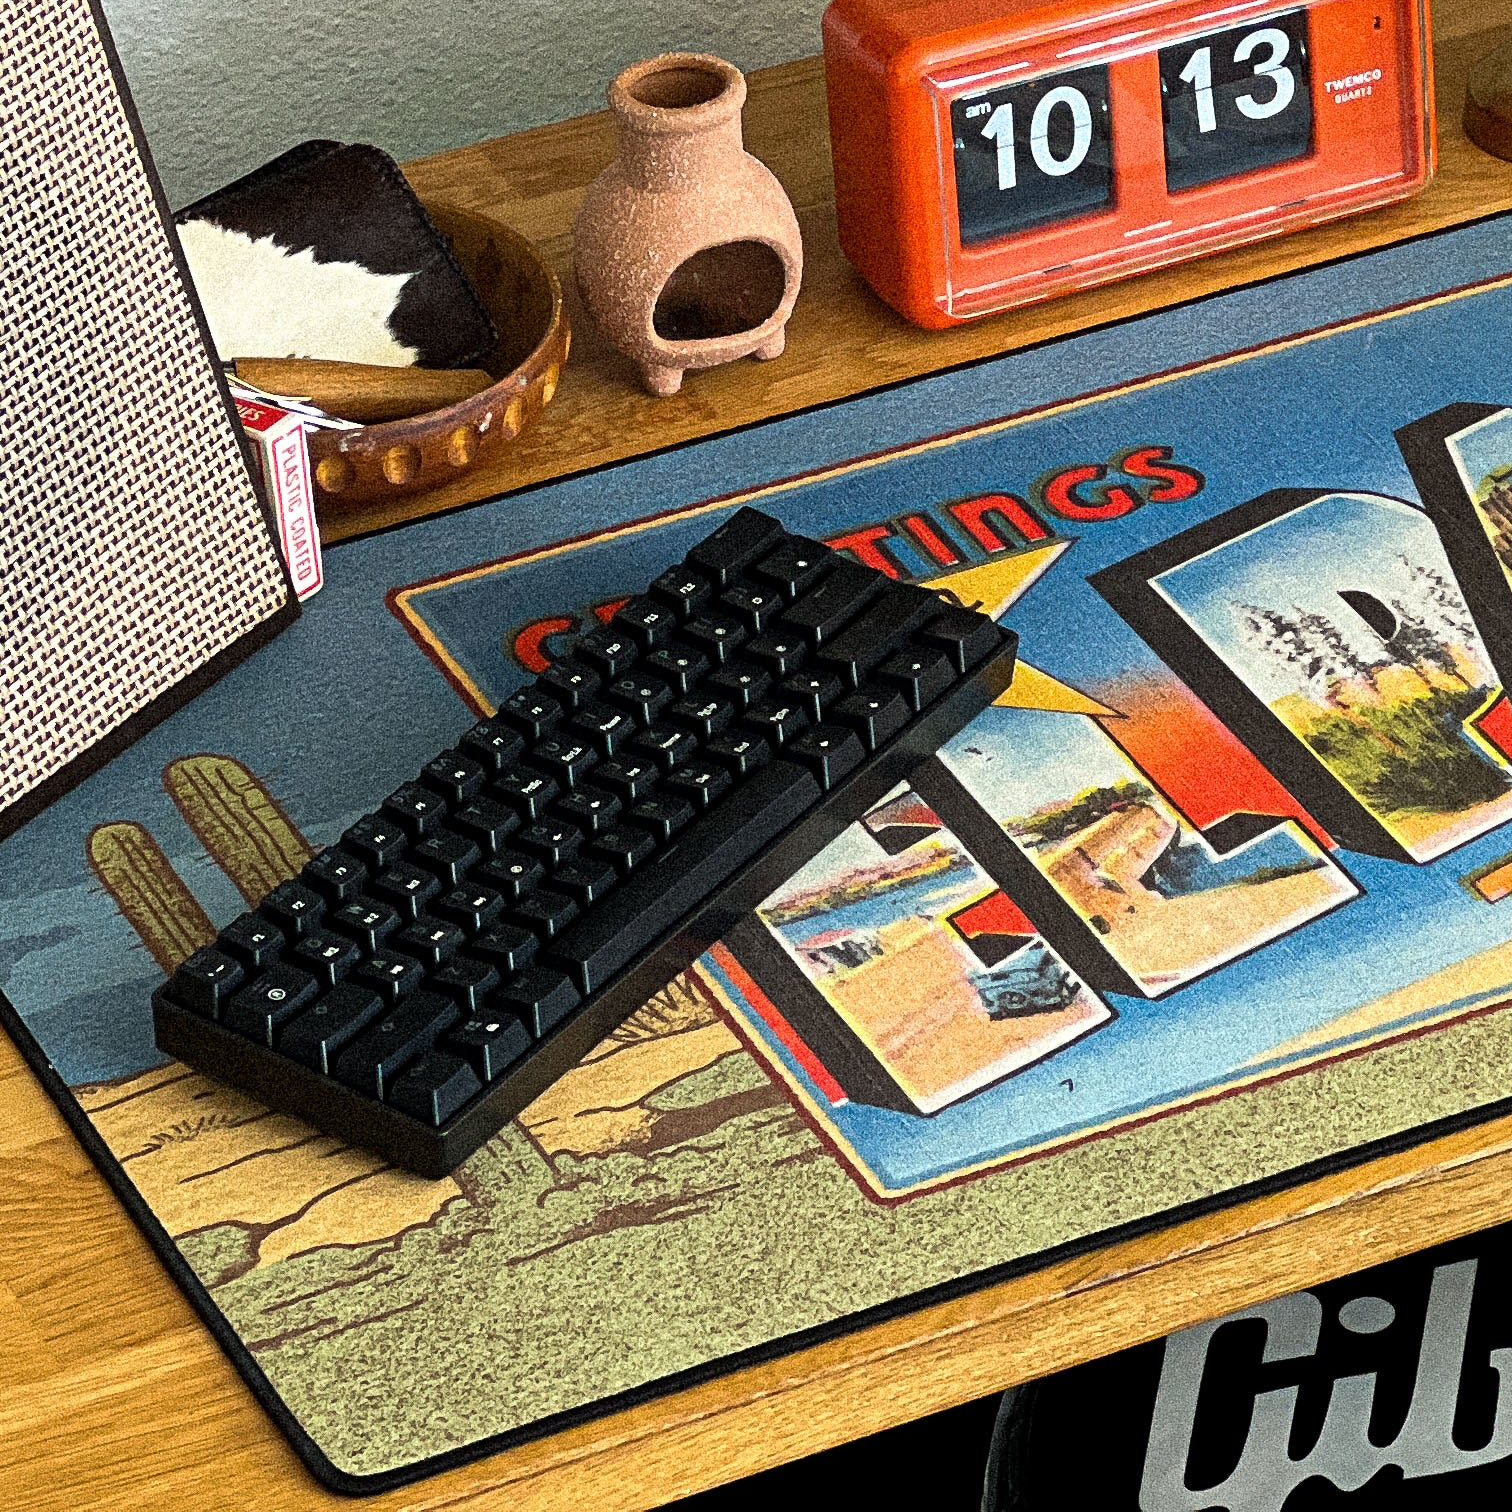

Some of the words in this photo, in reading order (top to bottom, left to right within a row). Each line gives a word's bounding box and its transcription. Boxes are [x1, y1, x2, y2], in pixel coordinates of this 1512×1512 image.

[965, 101, 992, 119] am
[1179, 27, 1296, 134] 13
[1324, 68, 1382, 93] TWEMCO
[980, 85, 1093, 191] 10
[281, 444, 302, 513] PLASTIC
[289, 516, 313, 582] COATED
